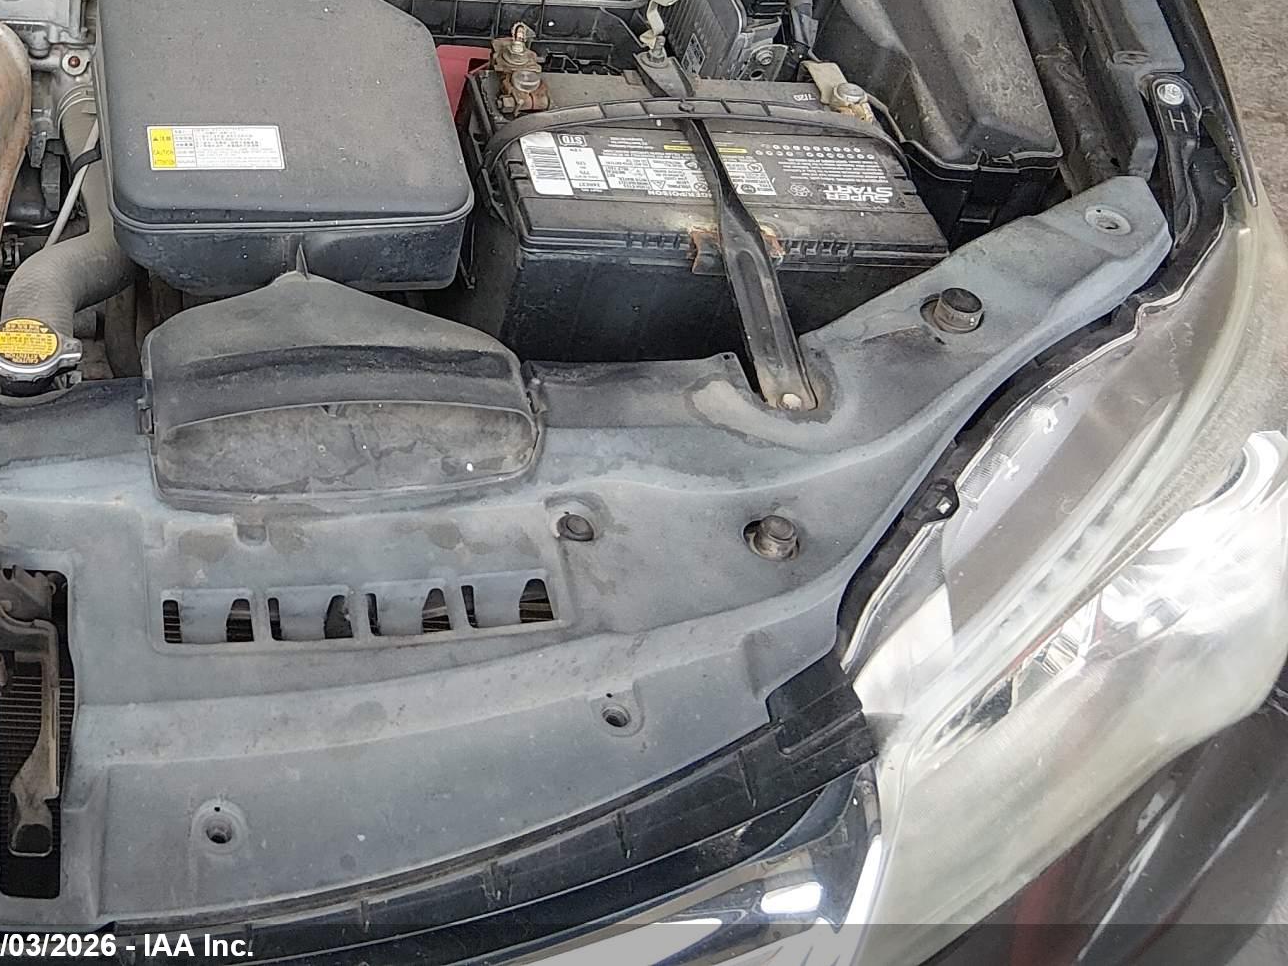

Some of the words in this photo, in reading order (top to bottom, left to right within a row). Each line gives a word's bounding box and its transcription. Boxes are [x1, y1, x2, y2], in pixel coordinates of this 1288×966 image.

[1168, 109, 1189, 133] H
[824, 184, 894, 197] START
[826, 191, 890, 203] SUPER
